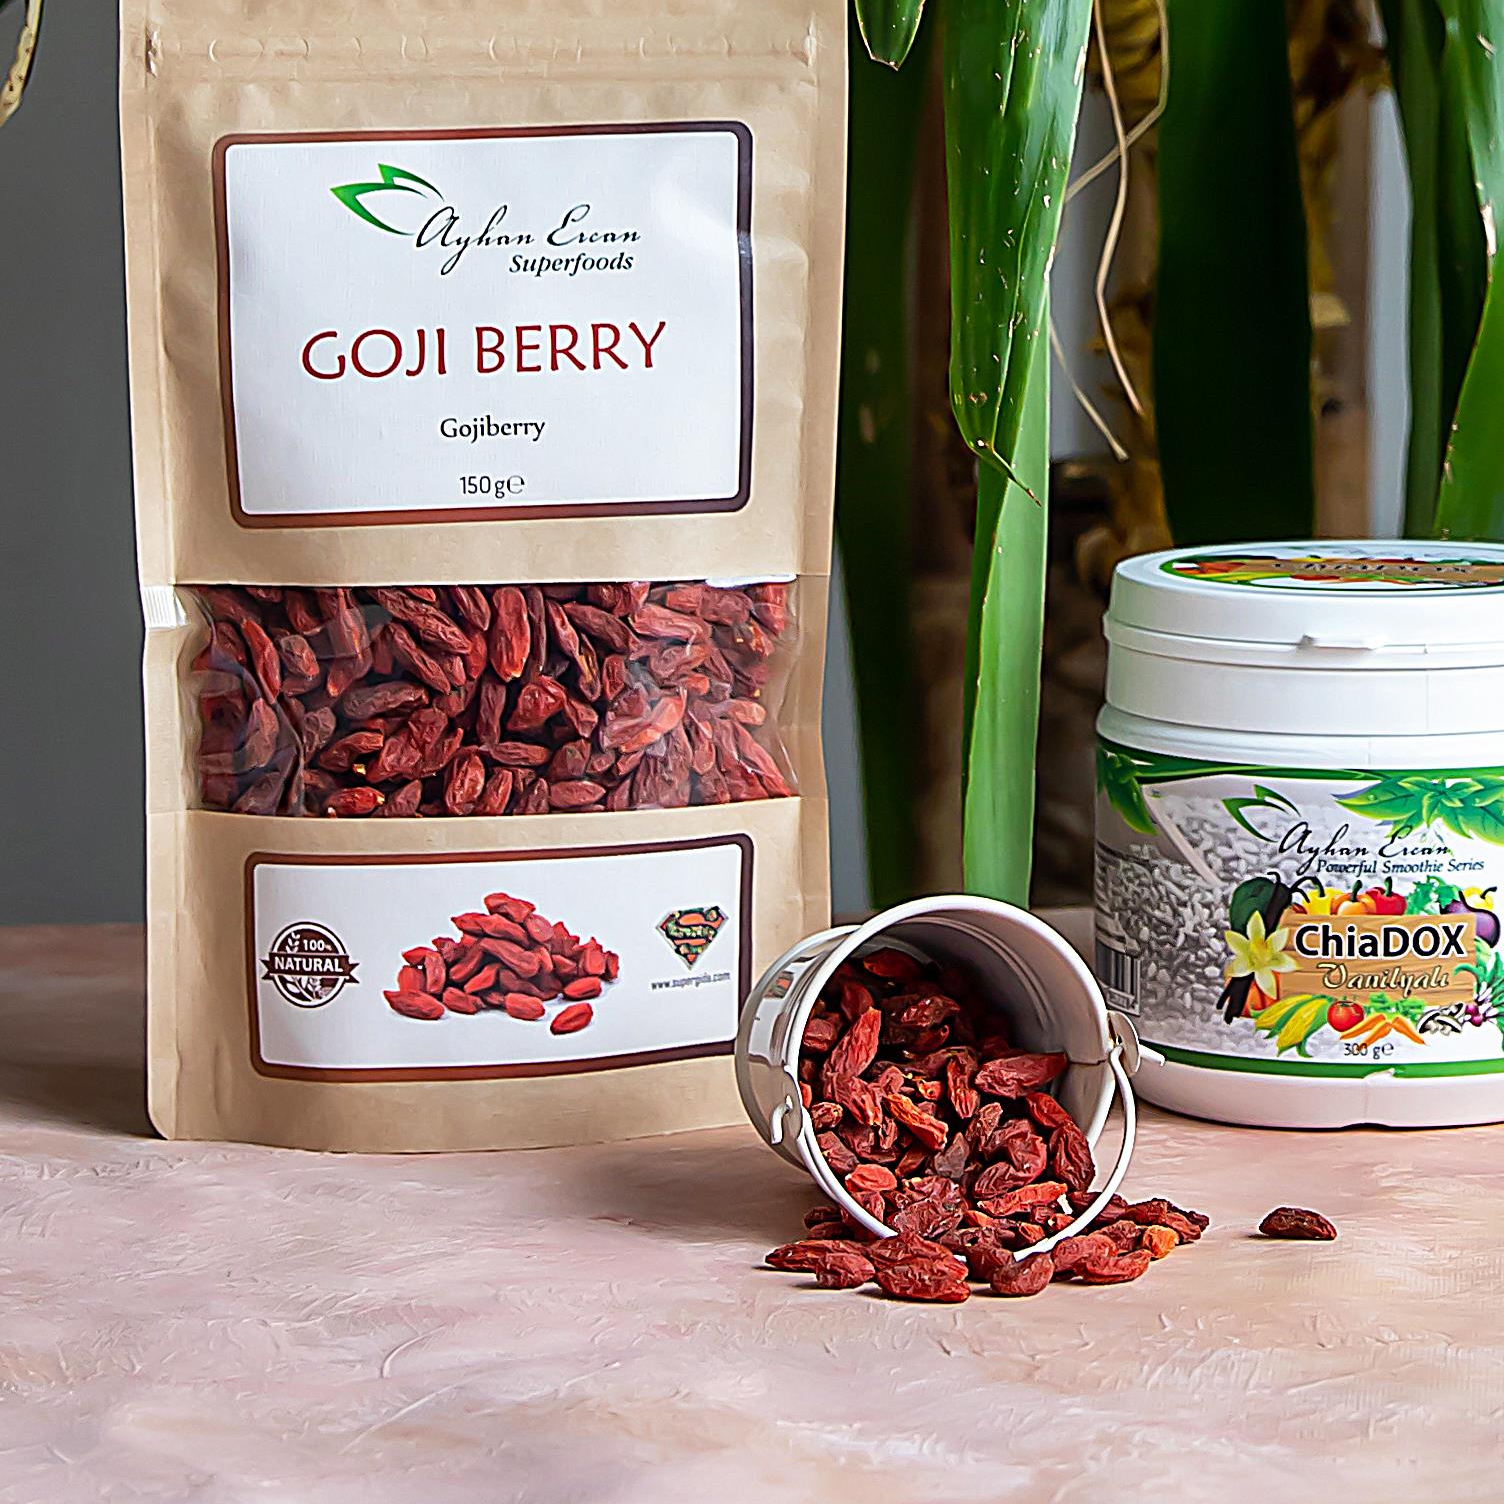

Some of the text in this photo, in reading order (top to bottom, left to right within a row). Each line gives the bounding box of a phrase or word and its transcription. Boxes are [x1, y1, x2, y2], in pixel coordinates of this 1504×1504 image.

[416, 205, 535, 276] Ayhan
[509, 251, 634, 278] Superfoods
[302, 321, 666, 380] GOJI BERRY
[440, 415, 546, 444] Gojiberry
[459, 475, 489, 496] 150
[1279, 821, 1369, 876] Ayhan
[1316, 857, 1485, 875] Powerful Smoothie Series
[1295, 924, 1466, 958] ChiaDOX
[274, 956, 344, 973] NATURAL
